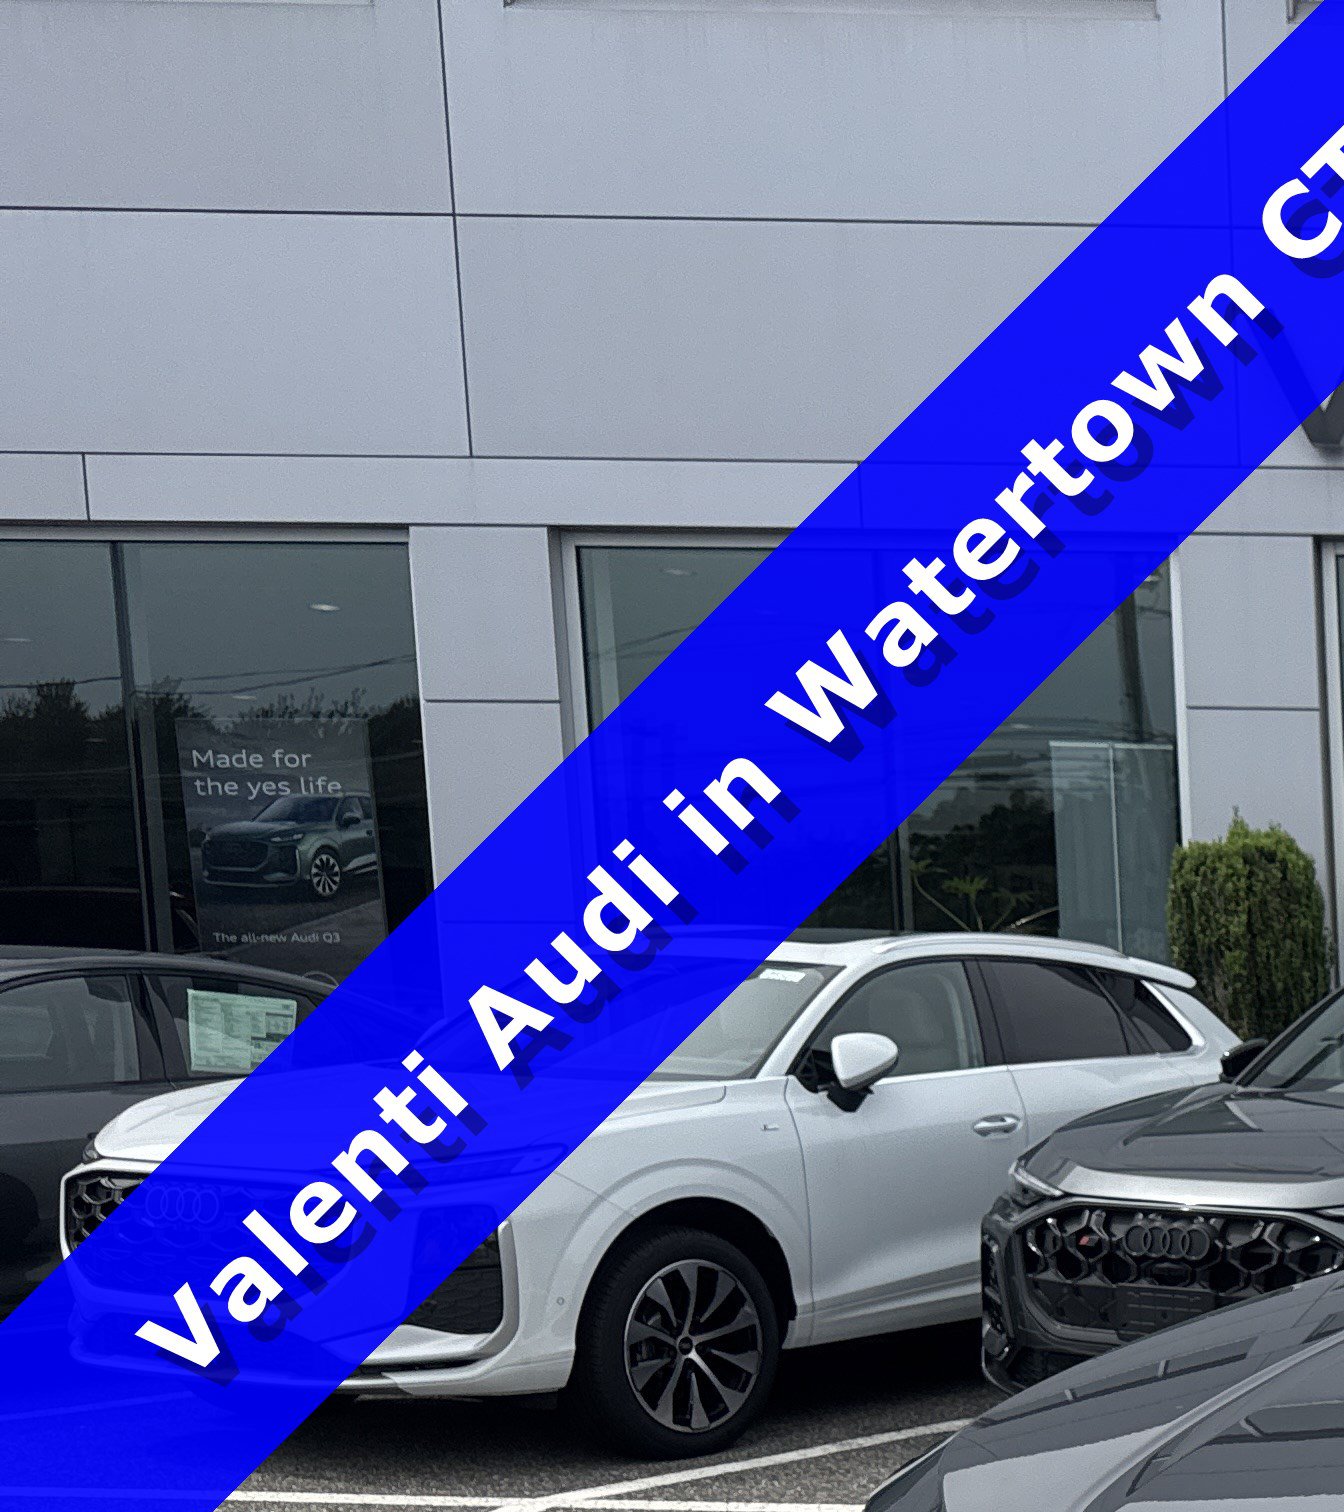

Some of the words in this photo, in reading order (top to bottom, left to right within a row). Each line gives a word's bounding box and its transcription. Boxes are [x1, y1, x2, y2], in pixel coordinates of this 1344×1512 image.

[191, 749, 263, 768] Made
[272, 749, 312, 768] for
[194, 777, 239, 796] the
[247, 780, 291, 800] yes
[300, 776, 342, 795] life
[213, 932, 237, 943] The
[291, 932, 319, 943] Audi
[323, 932, 341, 944] Q3
